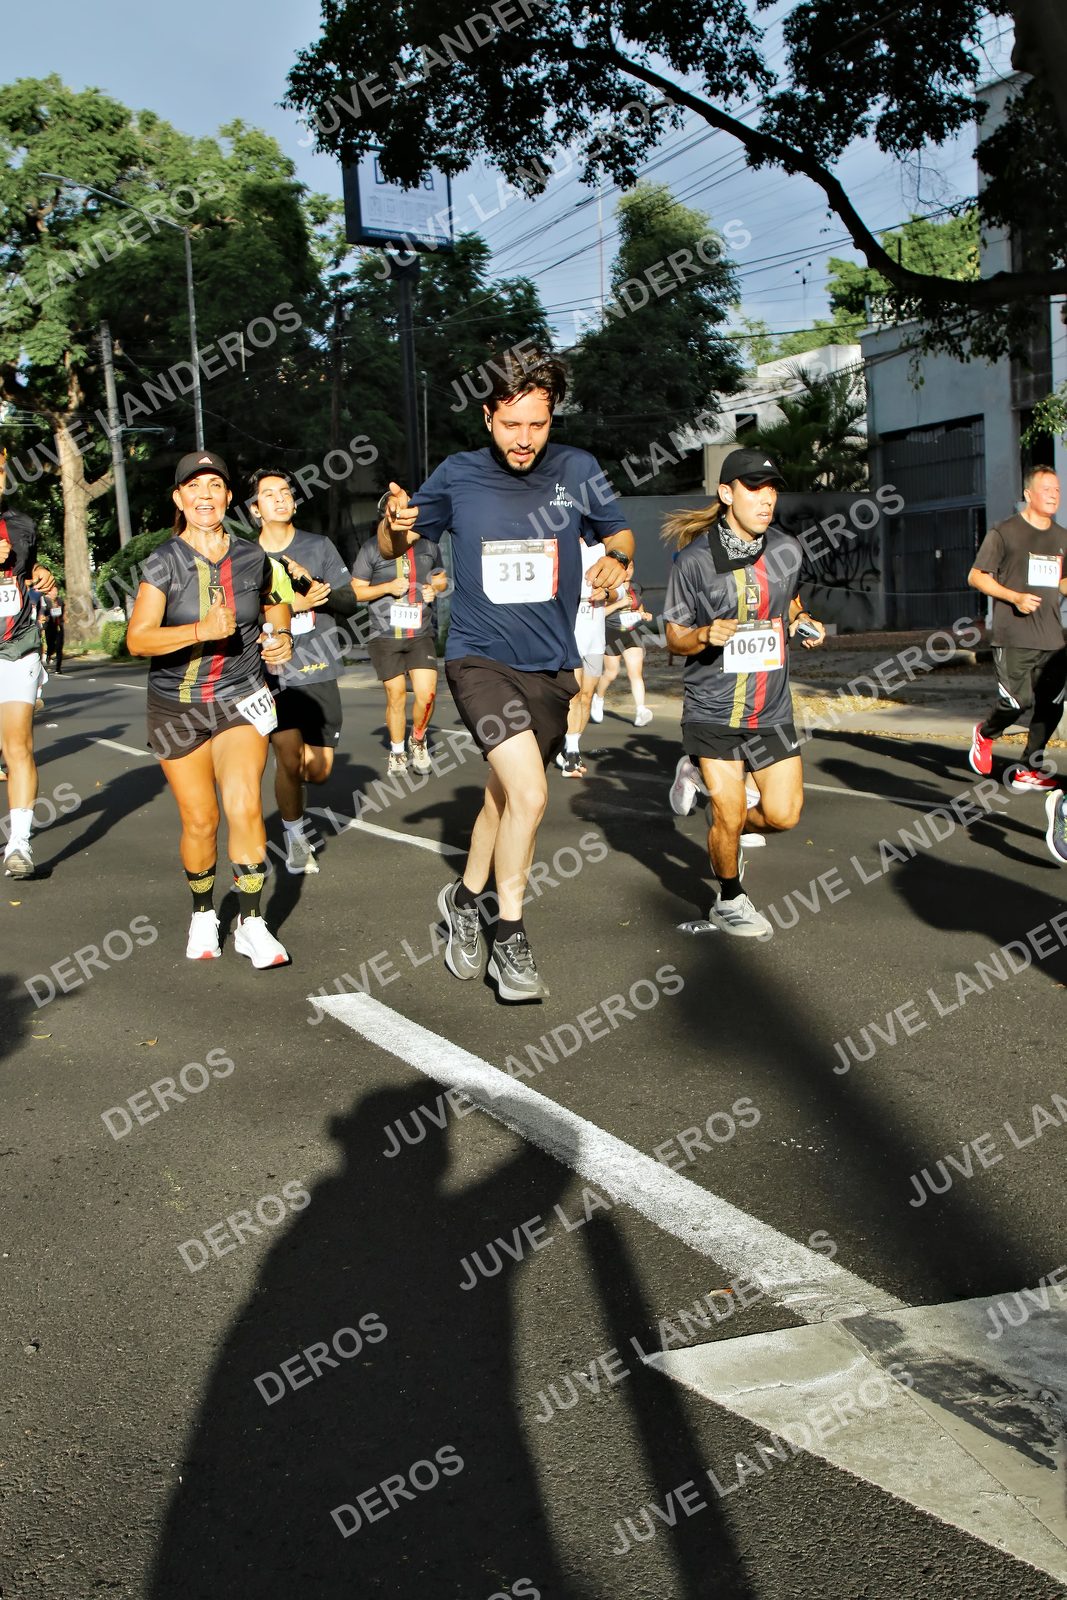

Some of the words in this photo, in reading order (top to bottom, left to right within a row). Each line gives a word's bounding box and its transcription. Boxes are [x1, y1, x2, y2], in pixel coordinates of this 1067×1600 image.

[556, 483, 566, 493] for
[499, 561, 536, 582] 313
[0, 590, 17, 602] 37
[726, 636, 777, 656] 10679
